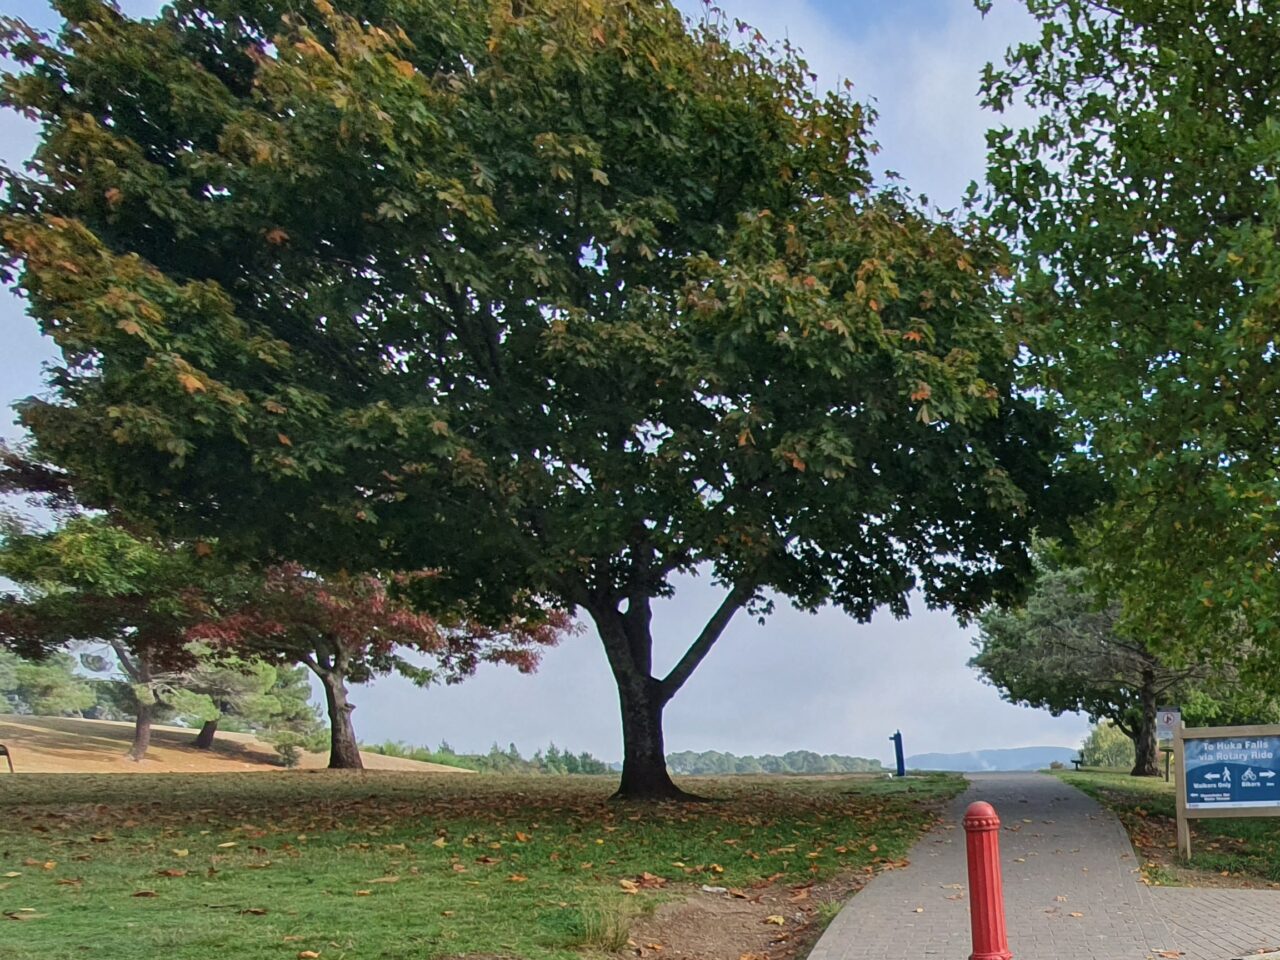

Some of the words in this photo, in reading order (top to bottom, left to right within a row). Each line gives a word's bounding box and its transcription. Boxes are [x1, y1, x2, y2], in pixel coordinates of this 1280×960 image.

[1203, 742, 1214, 750] To
[1245, 740, 1269, 749] Falls
[1216, 752, 1248, 761] Rotary
[1251, 751, 1273, 759] Ride
